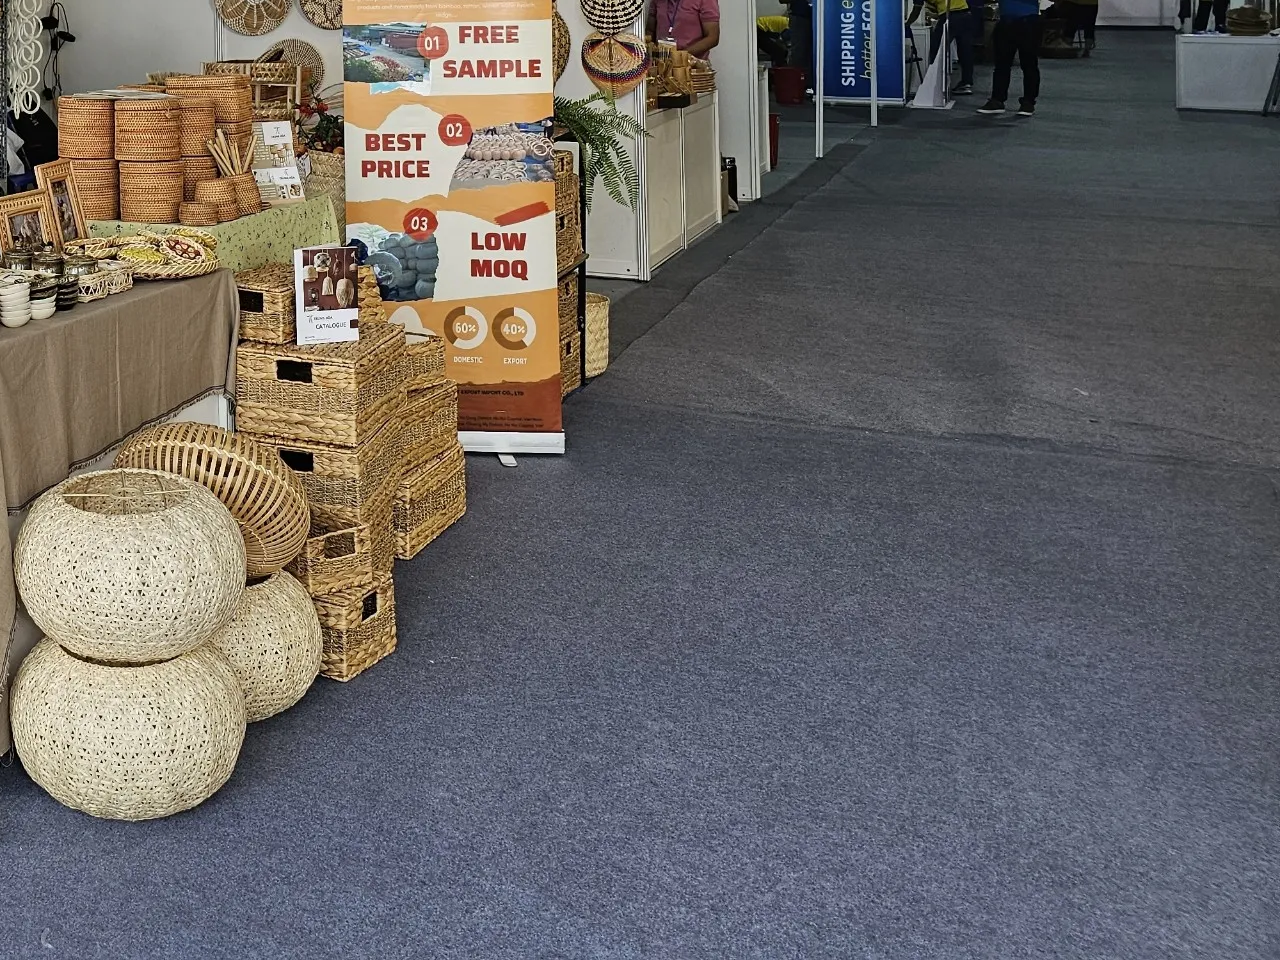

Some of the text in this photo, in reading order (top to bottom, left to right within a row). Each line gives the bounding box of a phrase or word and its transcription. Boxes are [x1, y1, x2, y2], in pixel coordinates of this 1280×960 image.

[424, 35, 440, 51] 01
[458, 25, 519, 44] FREE
[841, 12, 856, 87] SHIPPING
[442, 59, 542, 79] SAMPLE
[446, 122, 463, 138] 02
[365, 133, 427, 152] BEST
[361, 159, 430, 178] PRICE
[410, 215, 428, 232] 03
[470, 232, 527, 251] LOW
[470, 259, 529, 281] MOQ
[315, 321, 347, 330] CATALOGUE
[455, 321, 476, 335] 60%
[503, 322, 526, 336] 40%
[453, 356, 483, 365] DOMESTIC
[503, 356, 528, 365] EXPORT
